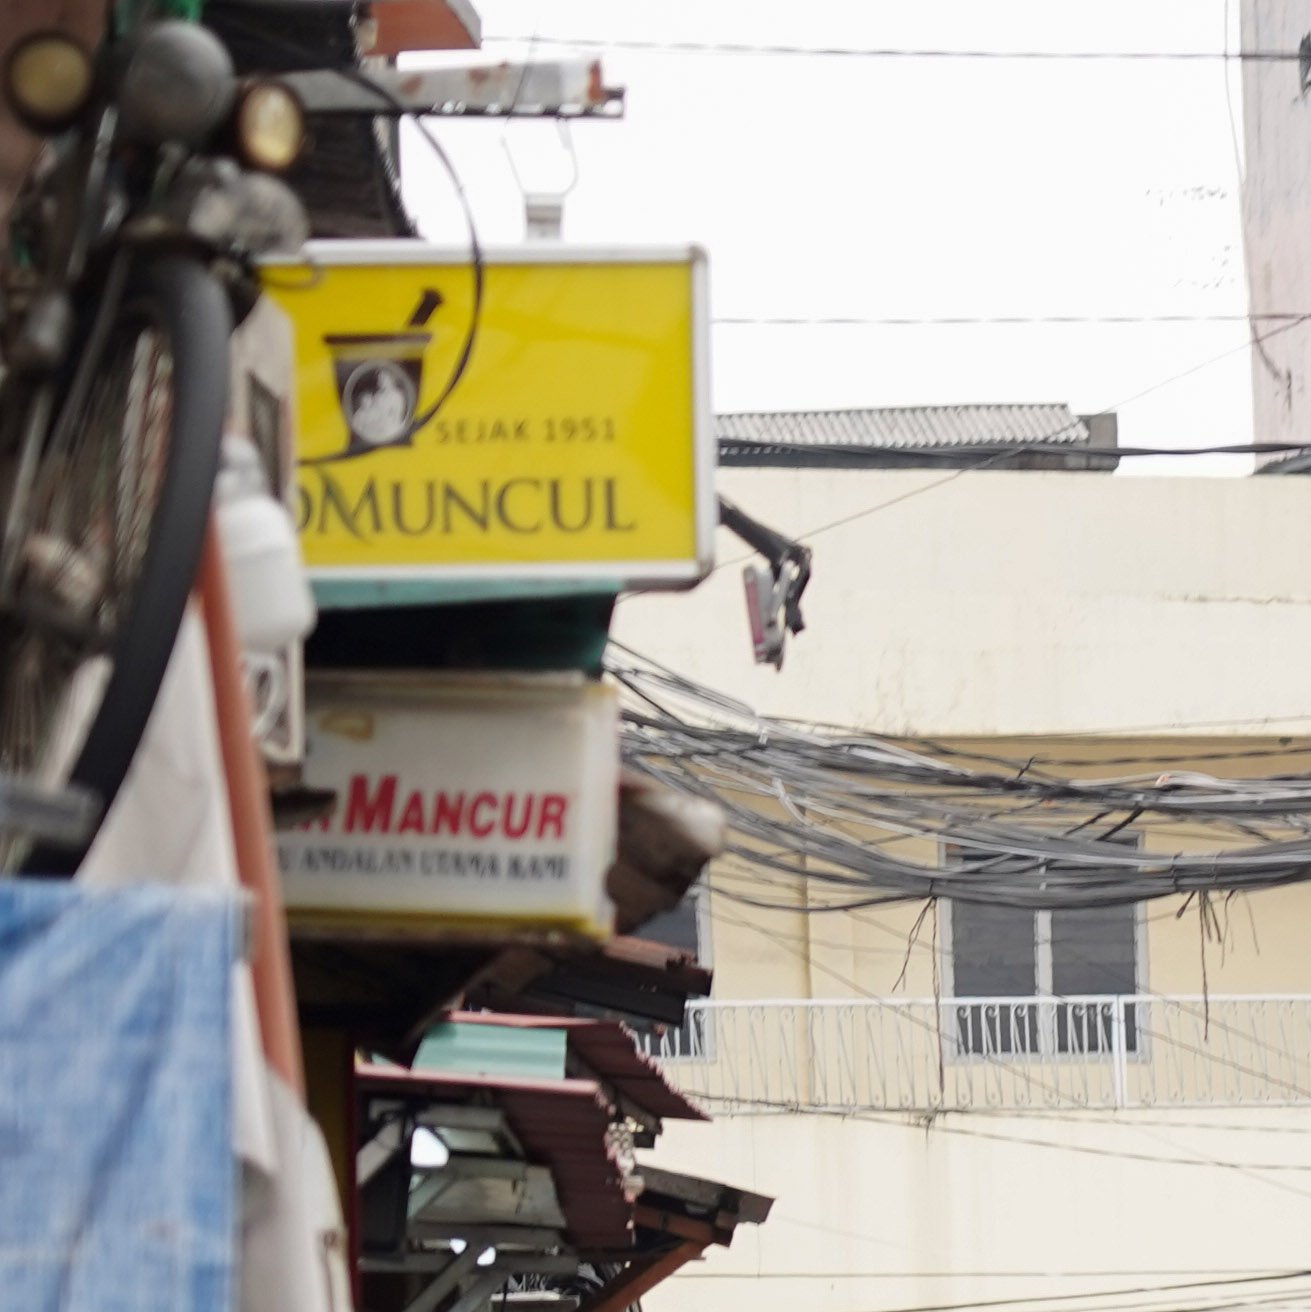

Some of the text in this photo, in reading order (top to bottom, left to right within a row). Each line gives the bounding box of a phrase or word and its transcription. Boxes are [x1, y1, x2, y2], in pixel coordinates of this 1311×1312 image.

[435, 417, 616, 445] SEJAK 1951
[345, 774, 570, 841] MANCUR
